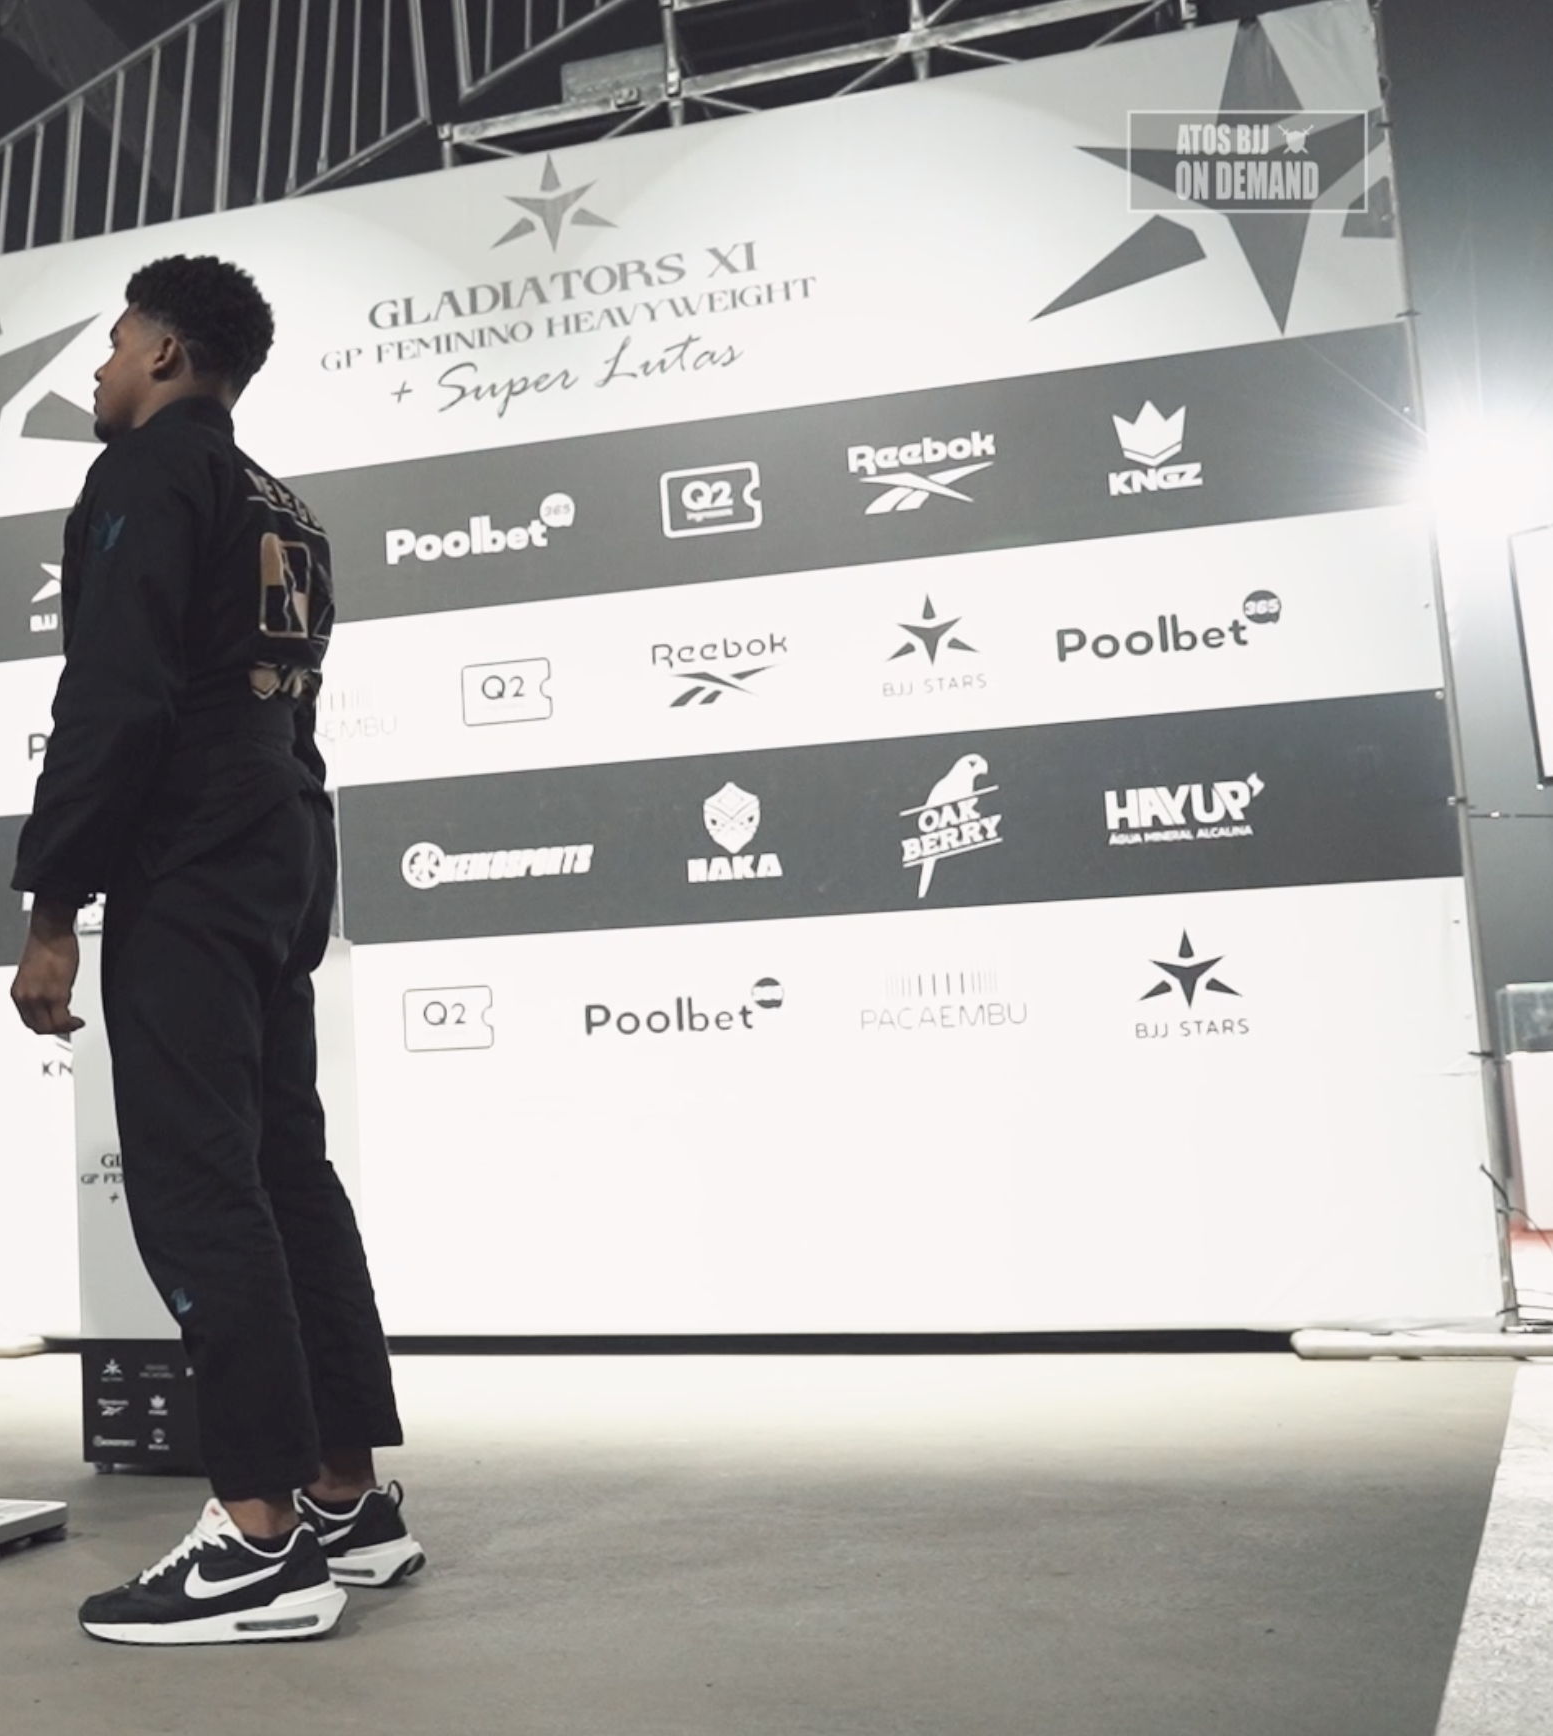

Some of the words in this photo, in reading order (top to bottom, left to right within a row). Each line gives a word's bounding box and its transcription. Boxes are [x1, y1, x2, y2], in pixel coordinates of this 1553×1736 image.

[368, 252, 686, 329] GLADIATORS
[705, 241, 758, 279] XI
[320, 347, 363, 372] GP
[376, 321, 534, 364] FEMININO
[546, 276, 818, 338] HEAVYWEIGHT
[437, 362, 580, 418] Super
[595, 334, 745, 387] Lutas
[848, 430, 997, 475] Reebok
[681, 480, 734, 511] Q2
[1108, 462, 1204, 496] KNGZ
[385, 514, 548, 565] Poolbet
[1055, 613, 1249, 662] Poolbet
[1244, 598, 1279, 616] 365
[651, 633, 788, 668] Reebok
[481, 675, 525, 701] Q2
[882, 681, 914, 697] BJJ
[924, 673, 987, 694] STARS
[917, 798, 981, 834] OAK
[1144, 829, 1194, 842] MINERAL
[1196, 825, 1254, 839] ALCALINA
[901, 815, 1003, 863] BERRY
[423, 1001, 466, 1026] Q2
[584, 996, 754, 1036] Poolbet
[861, 1002, 1027, 1031] PACAEMBU
[1135, 1022, 1169, 1039] BJJ
[1179, 1018, 1250, 1036] STARS
